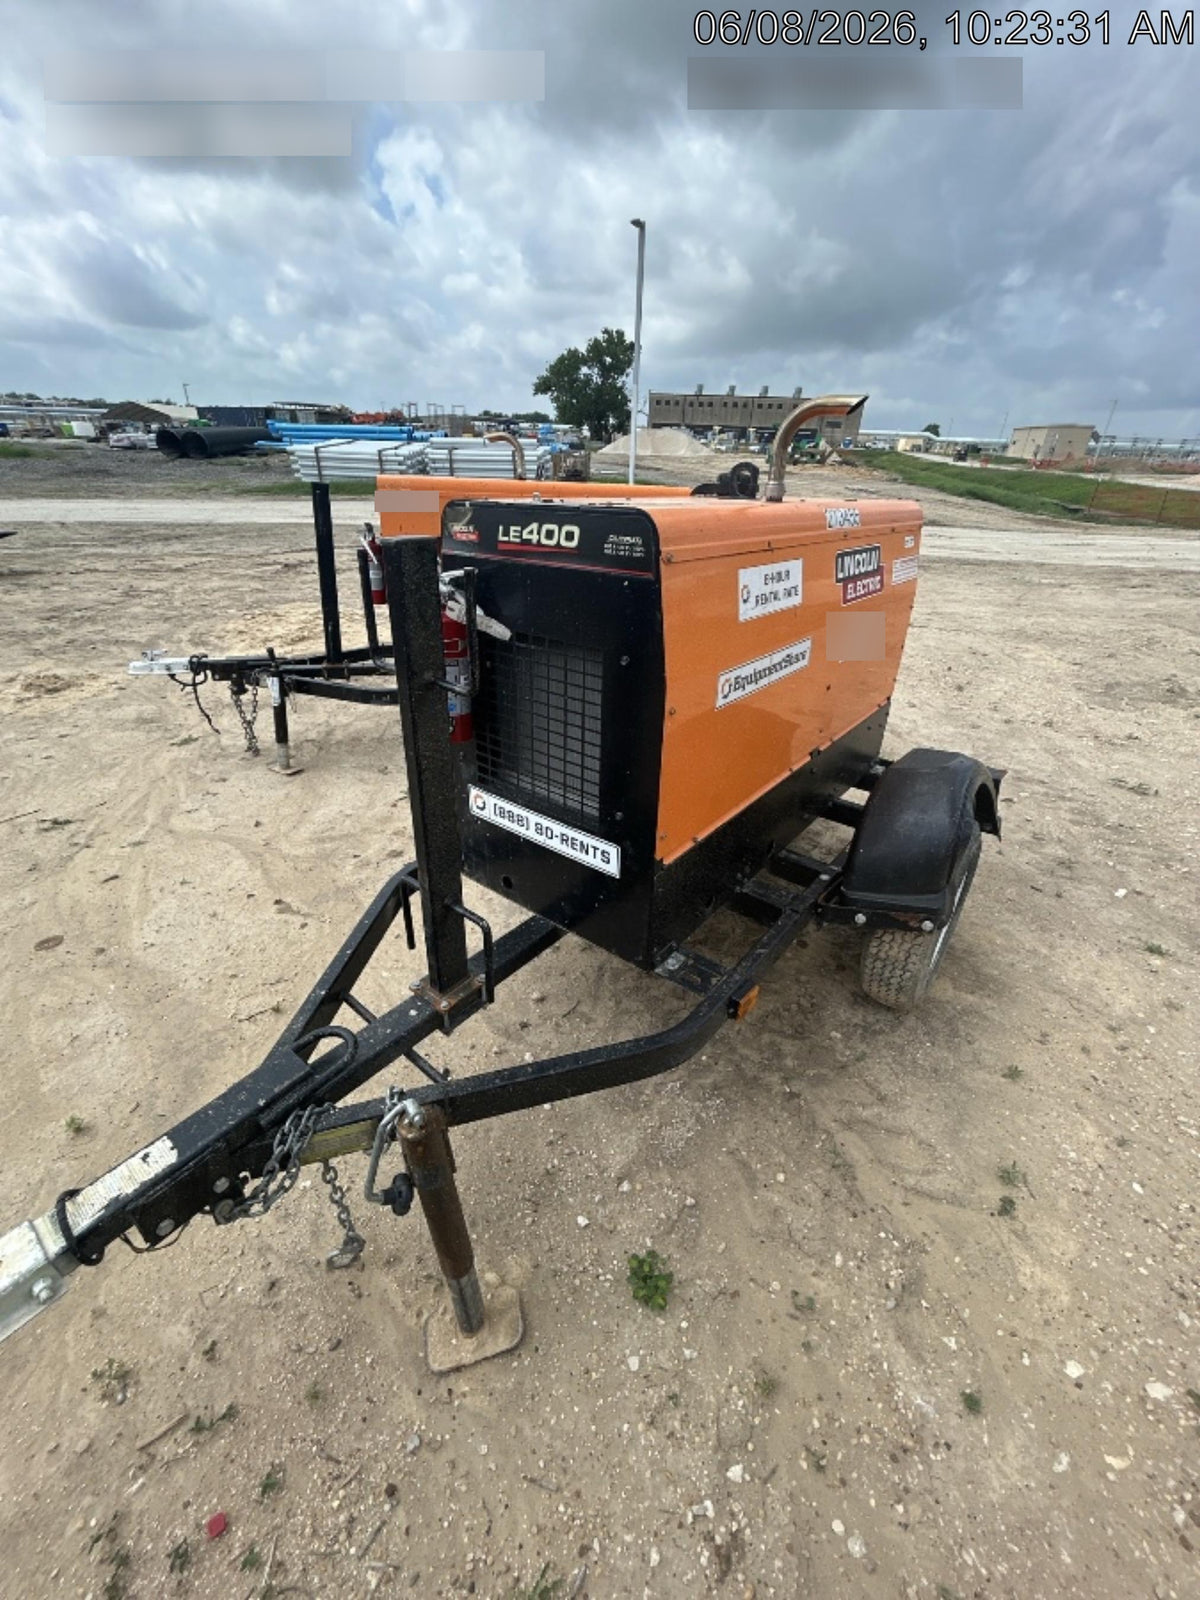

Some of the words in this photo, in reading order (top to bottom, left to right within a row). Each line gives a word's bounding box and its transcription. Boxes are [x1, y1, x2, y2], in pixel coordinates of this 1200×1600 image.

[498, 522, 580, 548] LE400
[837, 549, 879, 579] LINCOLN
[846, 575, 881, 600] ELECTRIC
[493, 803, 530, 831] (888)
[534, 822, 611, 865] 80-RENTS
